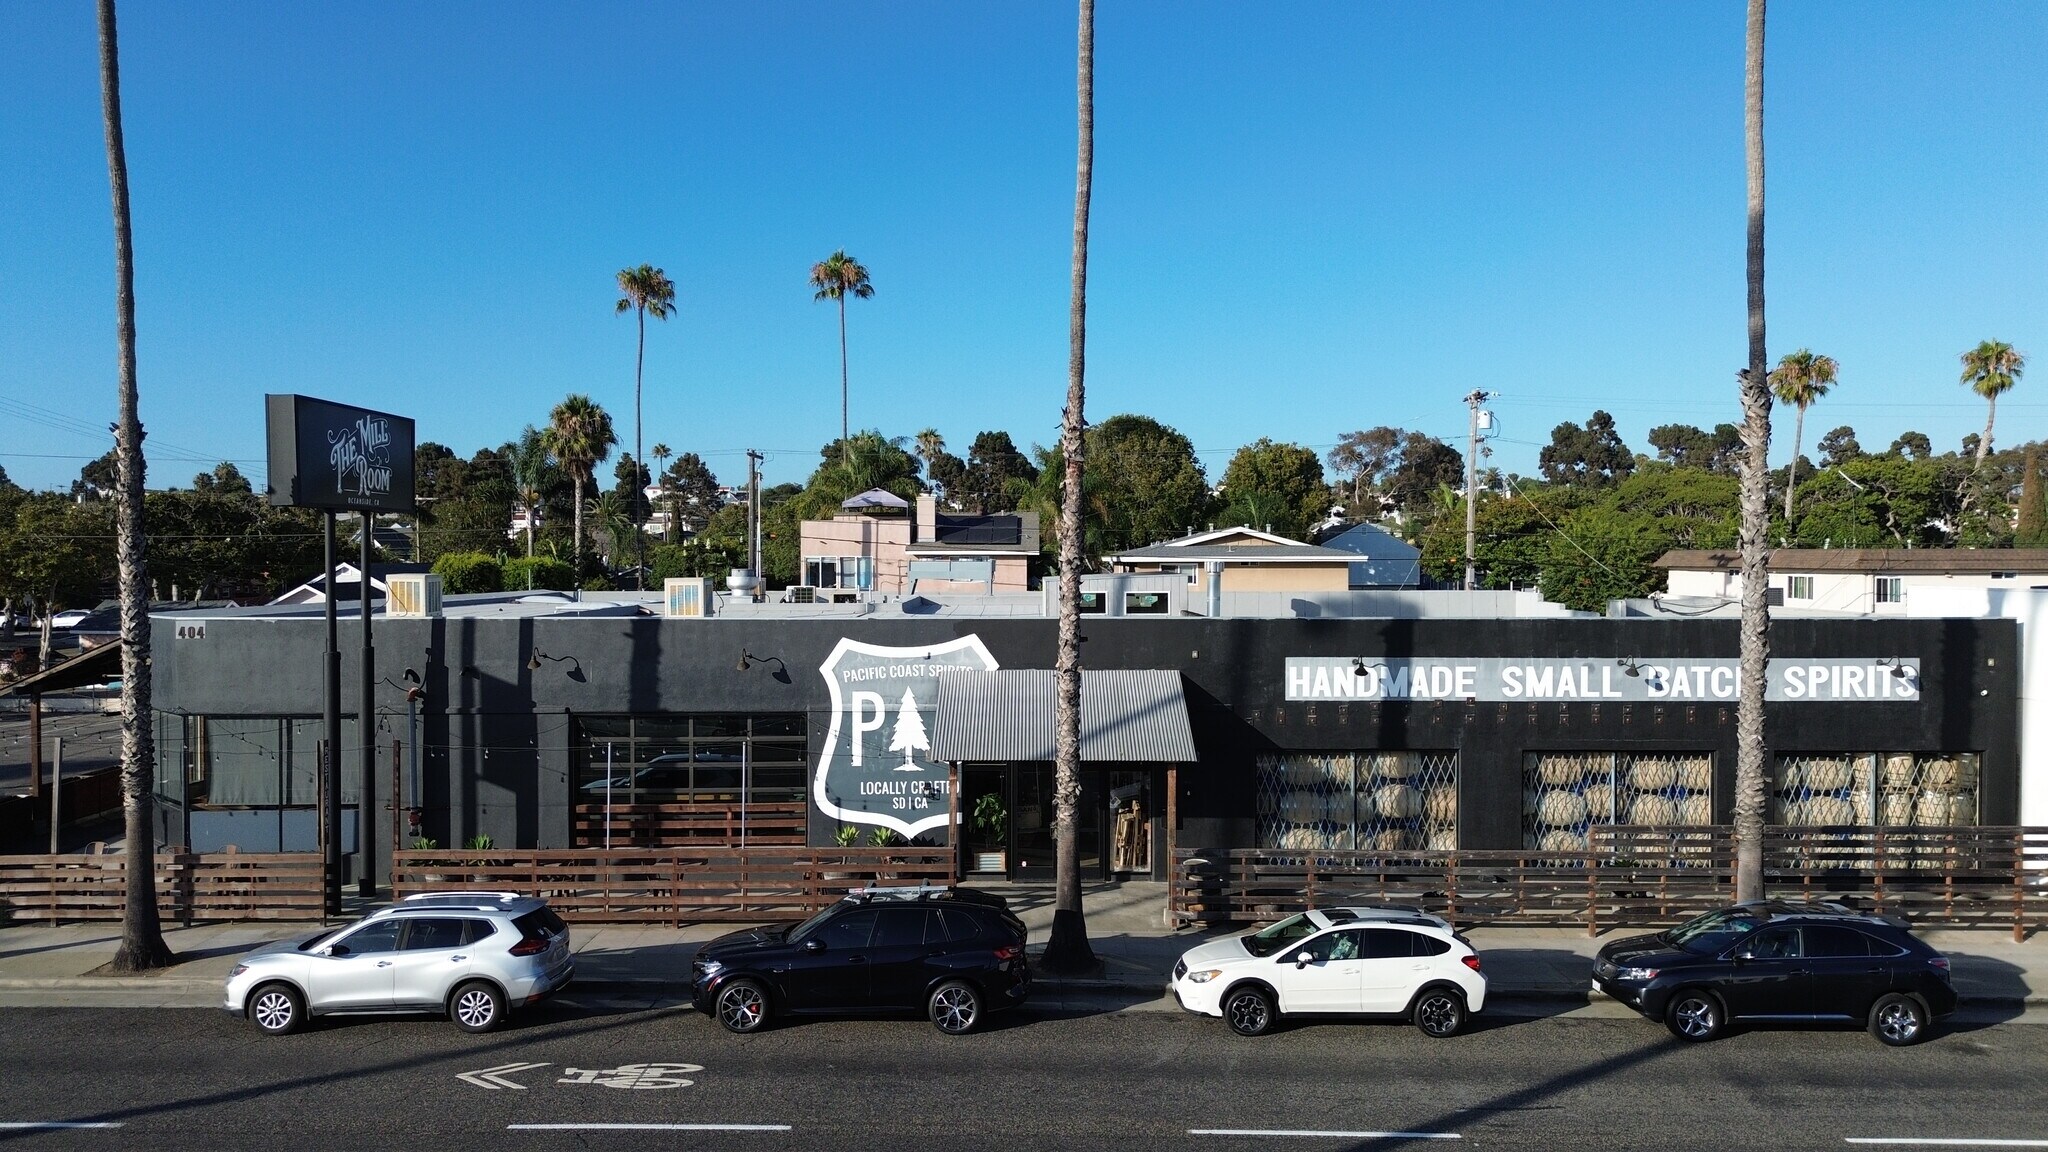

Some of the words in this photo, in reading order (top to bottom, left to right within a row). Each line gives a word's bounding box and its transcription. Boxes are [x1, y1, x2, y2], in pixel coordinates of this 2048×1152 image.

[329, 431, 358, 494] THE
[356, 414, 389, 455] MILL
[356, 455, 391, 496] ROOM
[178, 626, 205, 639] 404
[843, 666, 887, 683] PACIFIC
[890, 664, 926, 678] COAST
[1289, 666, 1477, 698] HANDMADE
[1501, 666, 1623, 698] SMALL
[1783, 665, 1917, 698] SPIRITS
[860, 781, 907, 795] LOCALLY
[892, 797, 906, 810] SD
[914, 797, 928, 809] CA
